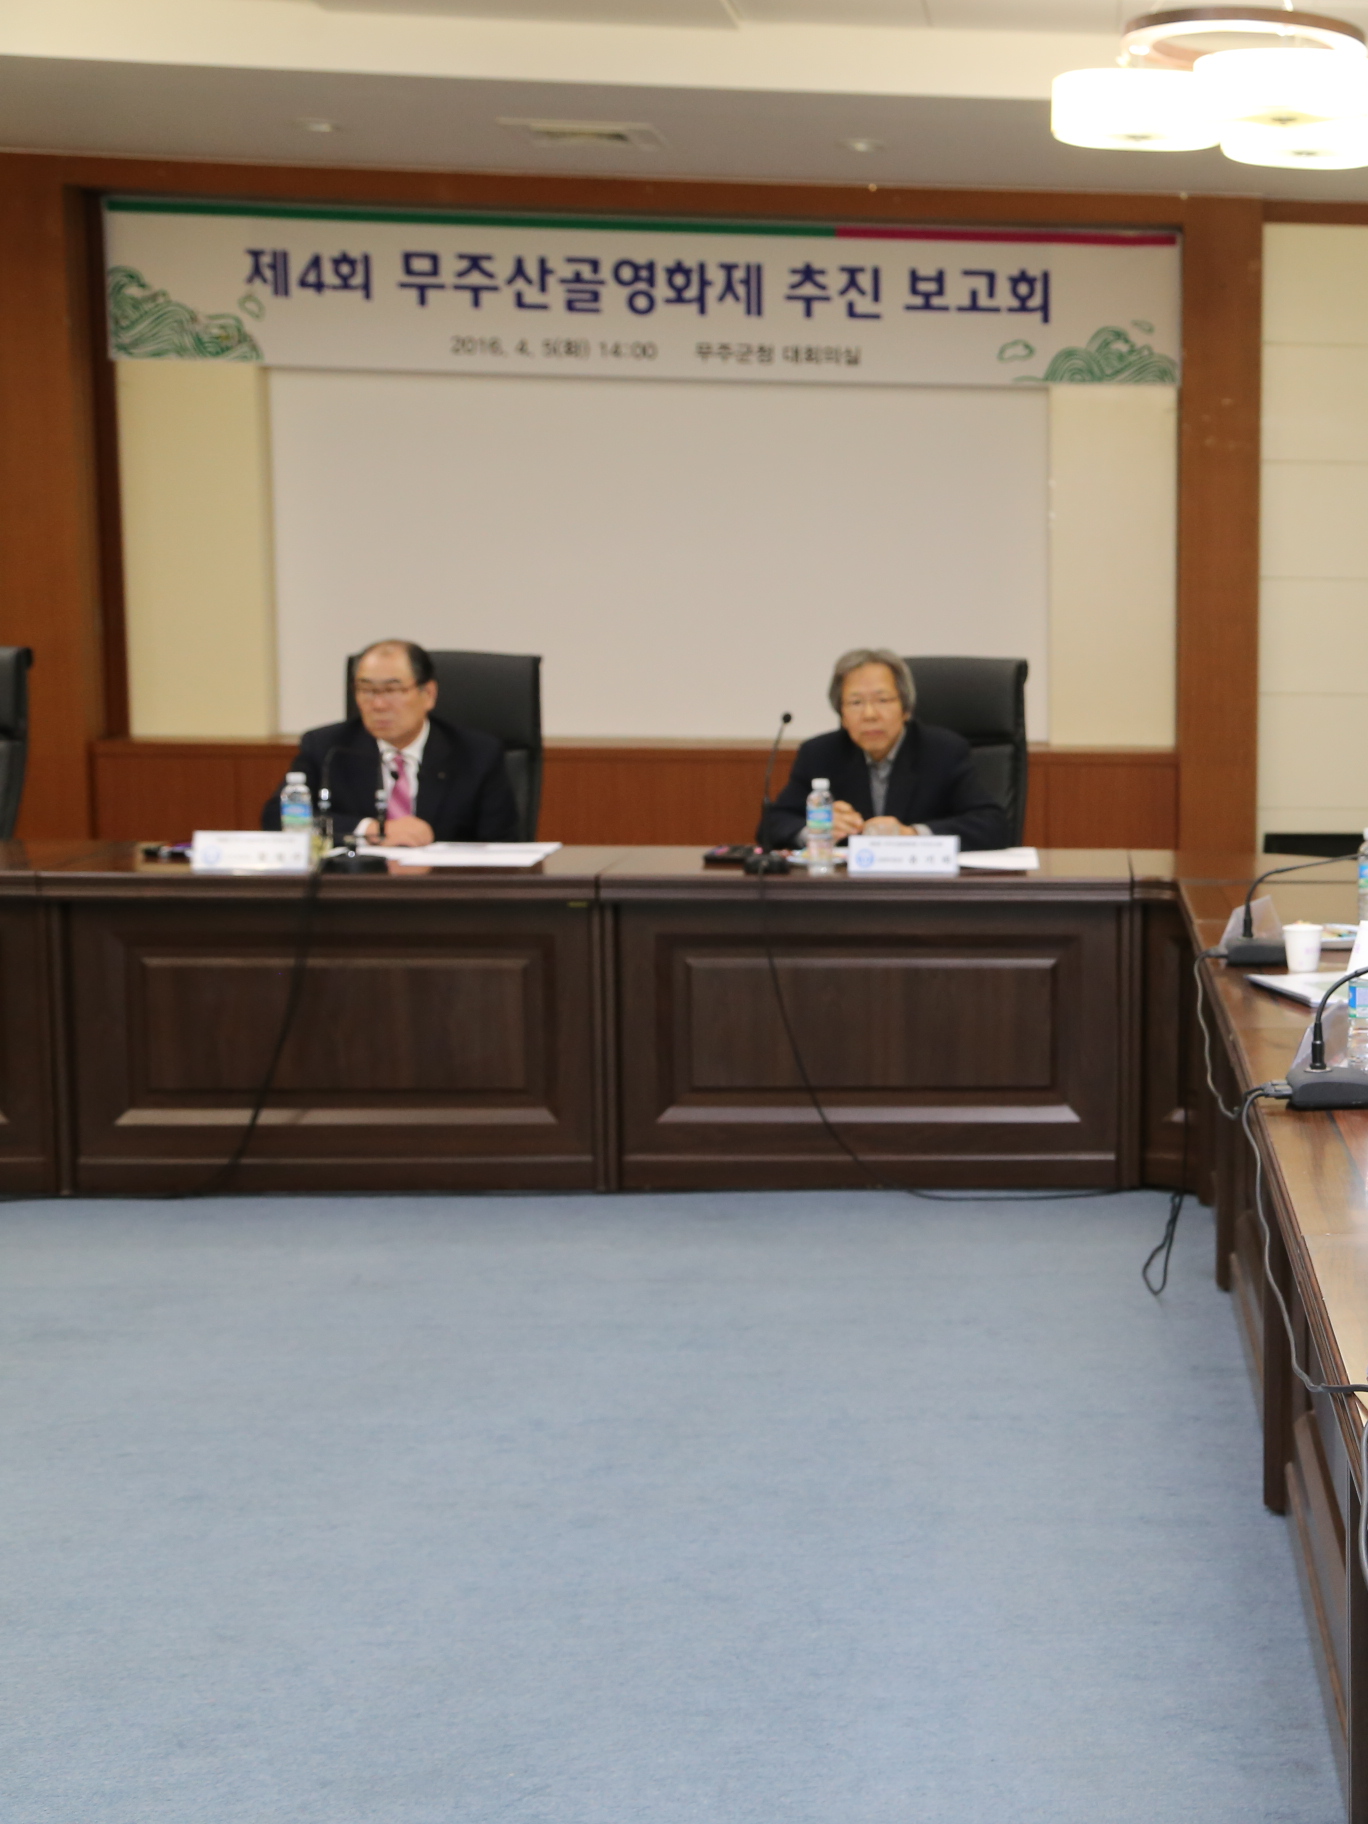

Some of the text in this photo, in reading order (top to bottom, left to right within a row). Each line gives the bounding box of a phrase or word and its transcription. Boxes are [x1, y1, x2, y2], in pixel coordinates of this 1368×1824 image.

[245, 249, 1050, 324] 제4회 무주산골영화제 추진 보고회
[600, 340, 659, 362] 14:00
[696, 342, 775, 367] 무주군청
[782, 345, 863, 367] 대회의실
